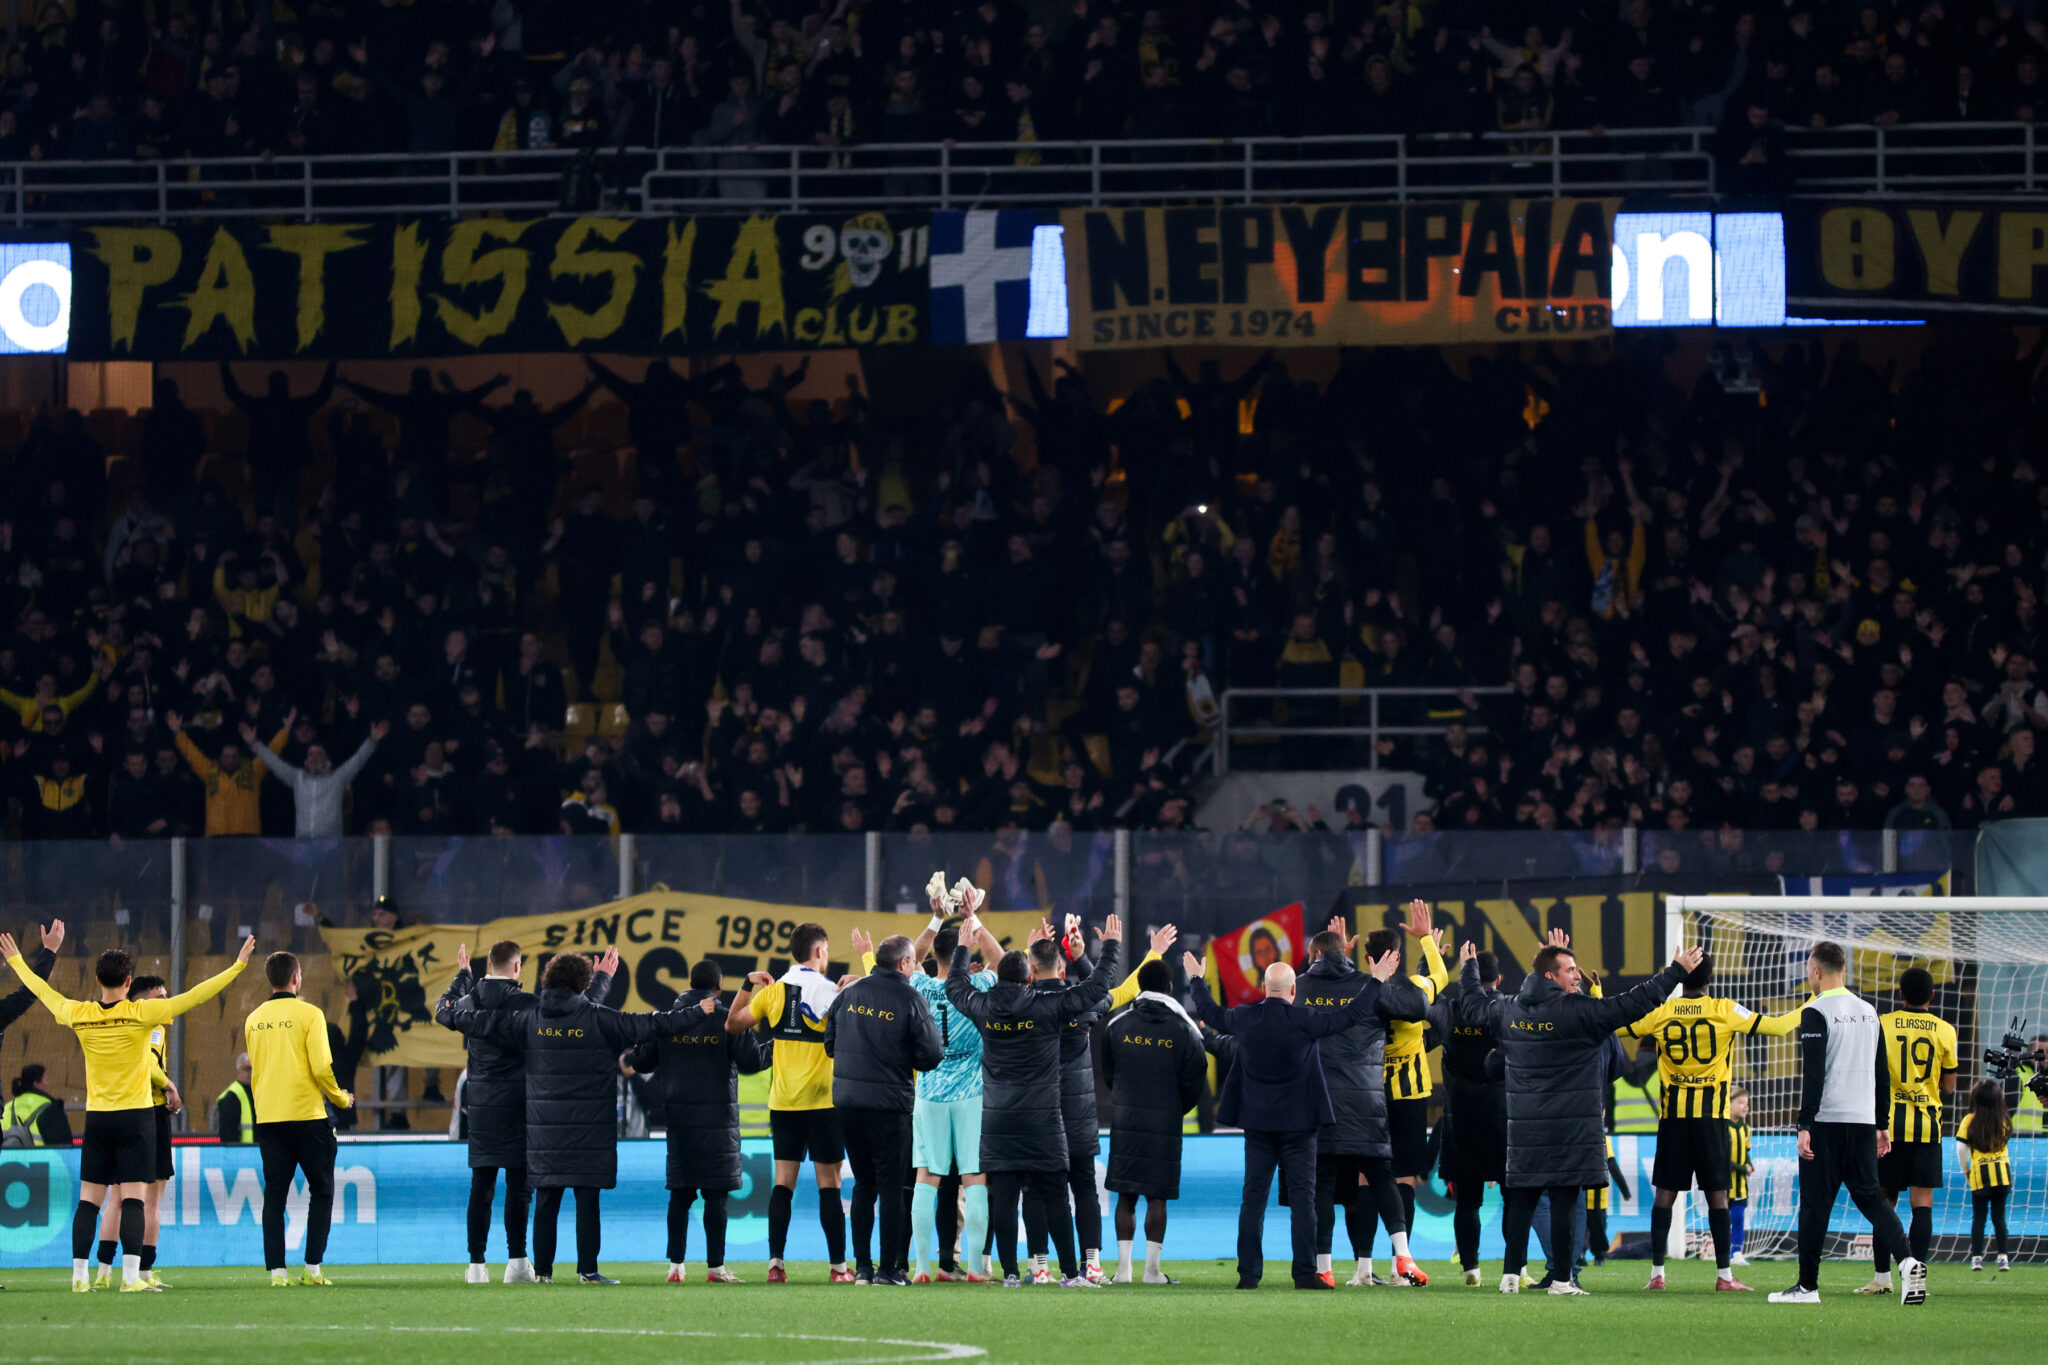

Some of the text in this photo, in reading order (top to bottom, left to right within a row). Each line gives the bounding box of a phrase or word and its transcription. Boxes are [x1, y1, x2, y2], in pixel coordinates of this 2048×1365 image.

[85, 213, 786, 356] PATISSIA
[793, 301, 918, 346] CLUB
[1093, 309, 1316, 344] SINCE 1974
[1496, 304, 1613, 334] CLUB
[541, 908, 799, 954] SINCE 1989
[878, 1010, 895, 1021] FC
[1017, 1020, 1034, 1030] FC
[1674, 1005, 1702, 1015] HAKIM
[1895, 1018, 1937, 1032] ELIASSON
[568, 1029, 584, 1037] FC
[937, 1004, 949, 1047] 1
[1538, 1022, 1554, 1031] FC
[1157, 1039, 1173, 1048] FC
[1663, 1018, 1717, 1065] 80
[1896, 1035, 1935, 1083] 19
